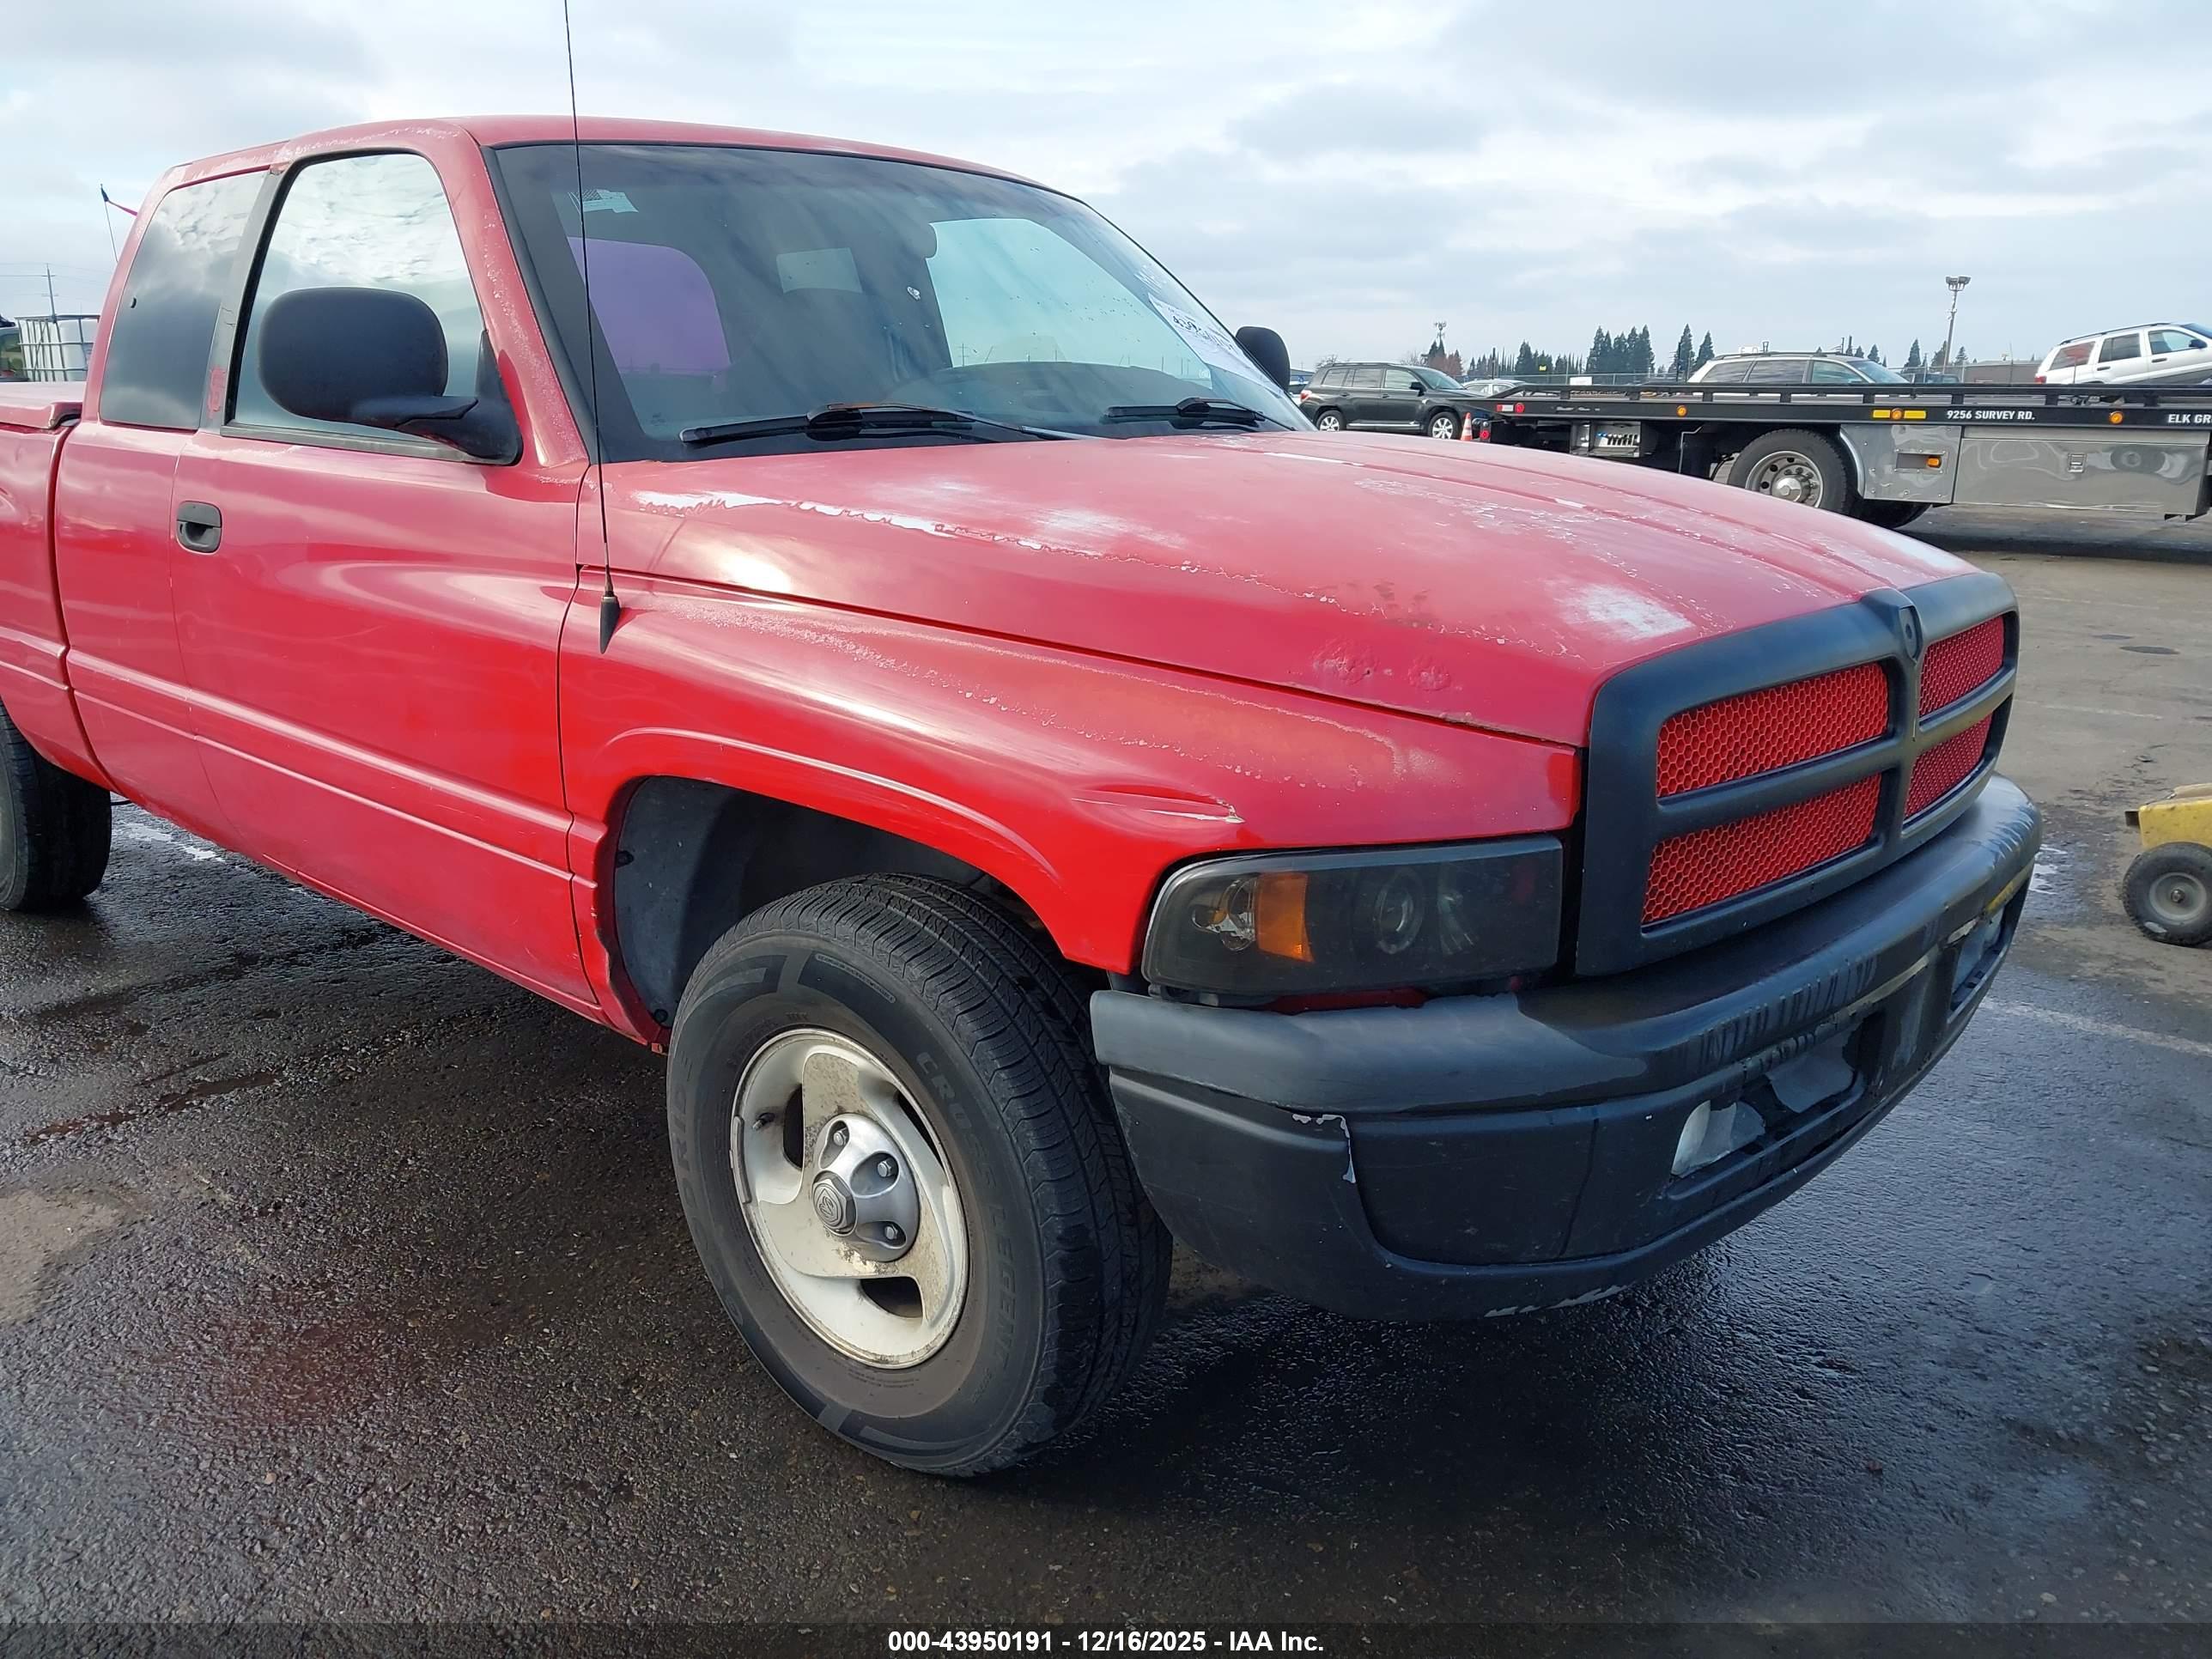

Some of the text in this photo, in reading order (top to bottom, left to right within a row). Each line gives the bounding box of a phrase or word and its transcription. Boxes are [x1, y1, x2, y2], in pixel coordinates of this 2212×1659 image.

[1946, 410, 2035, 421] 9256 SURVEY RD.
[2166, 413, 2212, 424] ELK GR
